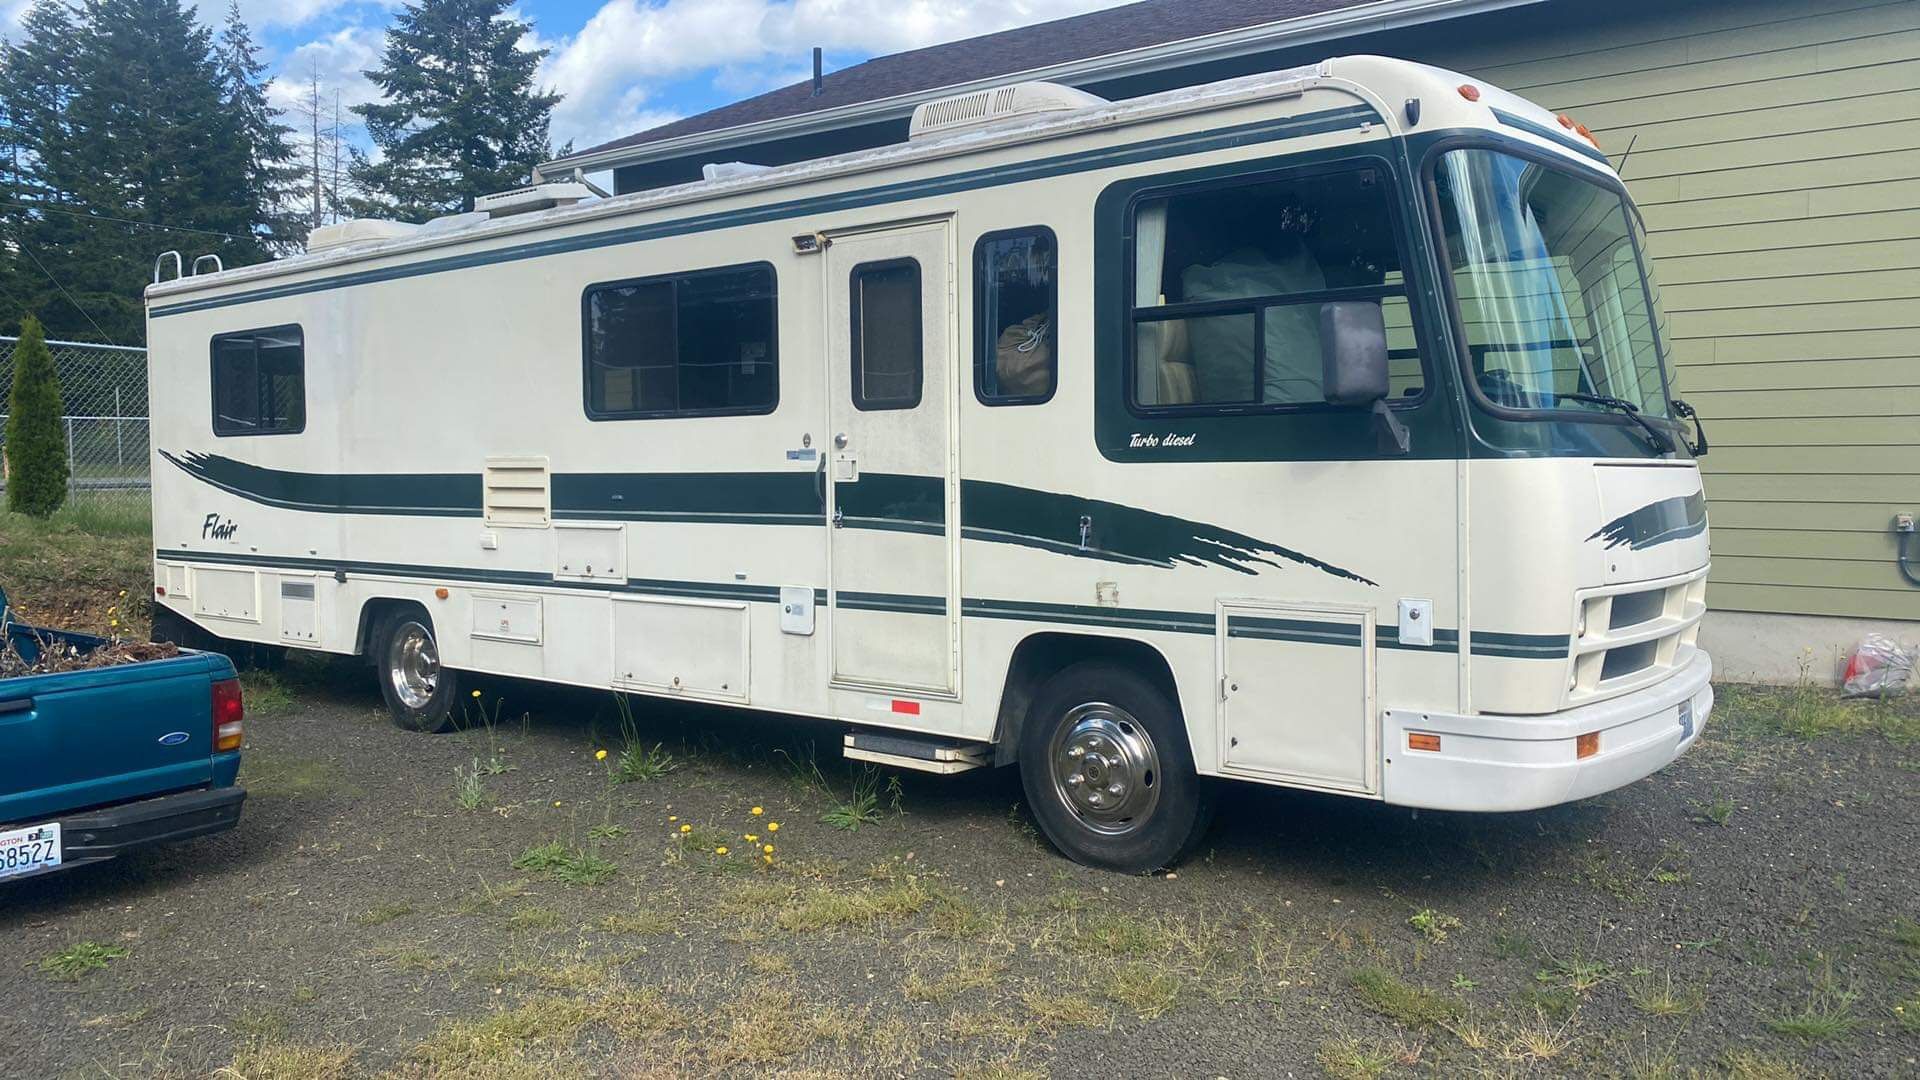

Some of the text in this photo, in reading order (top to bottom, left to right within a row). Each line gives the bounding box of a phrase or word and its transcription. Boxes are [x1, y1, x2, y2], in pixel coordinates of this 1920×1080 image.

[1129, 432, 1196, 448] Turbo diesel
[202, 513, 238, 540] Flair
